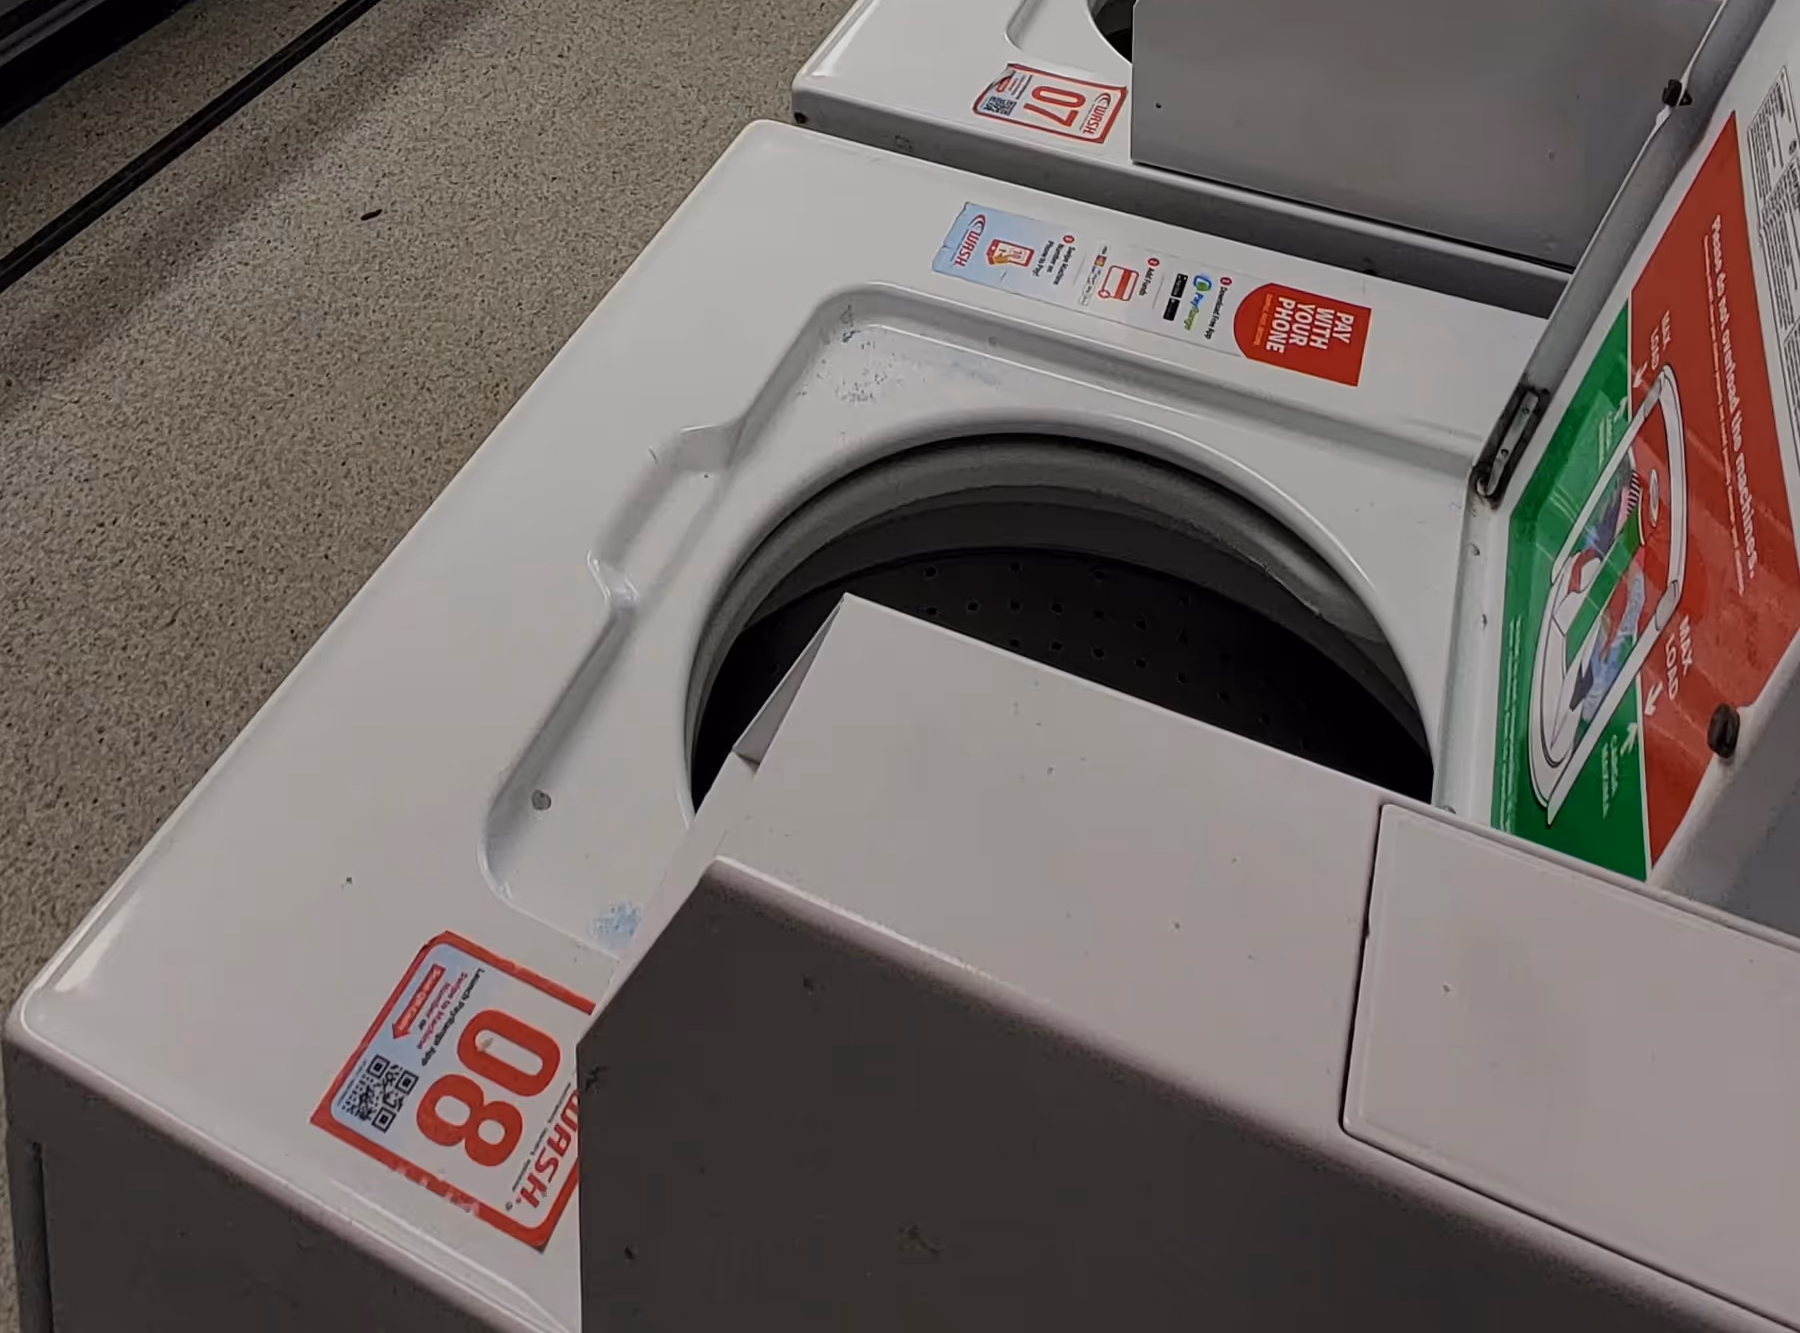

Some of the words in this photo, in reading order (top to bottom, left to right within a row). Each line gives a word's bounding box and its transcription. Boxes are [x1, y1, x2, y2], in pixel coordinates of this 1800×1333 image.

[1023, 86, 1086, 127] 07
[1083, 105, 1107, 134] WASH
[953, 230, 979, 267] WASH
[1712, 214, 1722, 274] Please
[1716, 272, 1726, 298] do
[1266, 296, 1296, 354] PHONE
[1288, 303, 1316, 346] YOUR
[1309, 308, 1335, 349] WITH
[1332, 312, 1355, 344] PAY
[1718, 295, 1730, 331] not
[1722, 328, 1740, 414] overload
[1731, 410, 1742, 452] the
[1736, 452, 1758, 578] machines.
[1680, 614, 1693, 677] MAX
[1665, 634, 1679, 701] LOAD
[461, 967, 485, 1001] Launch
[433, 1001, 465, 1046] PayRange
[421, 1046, 436, 1067] App
[416, 1009, 561, 1167] 08
